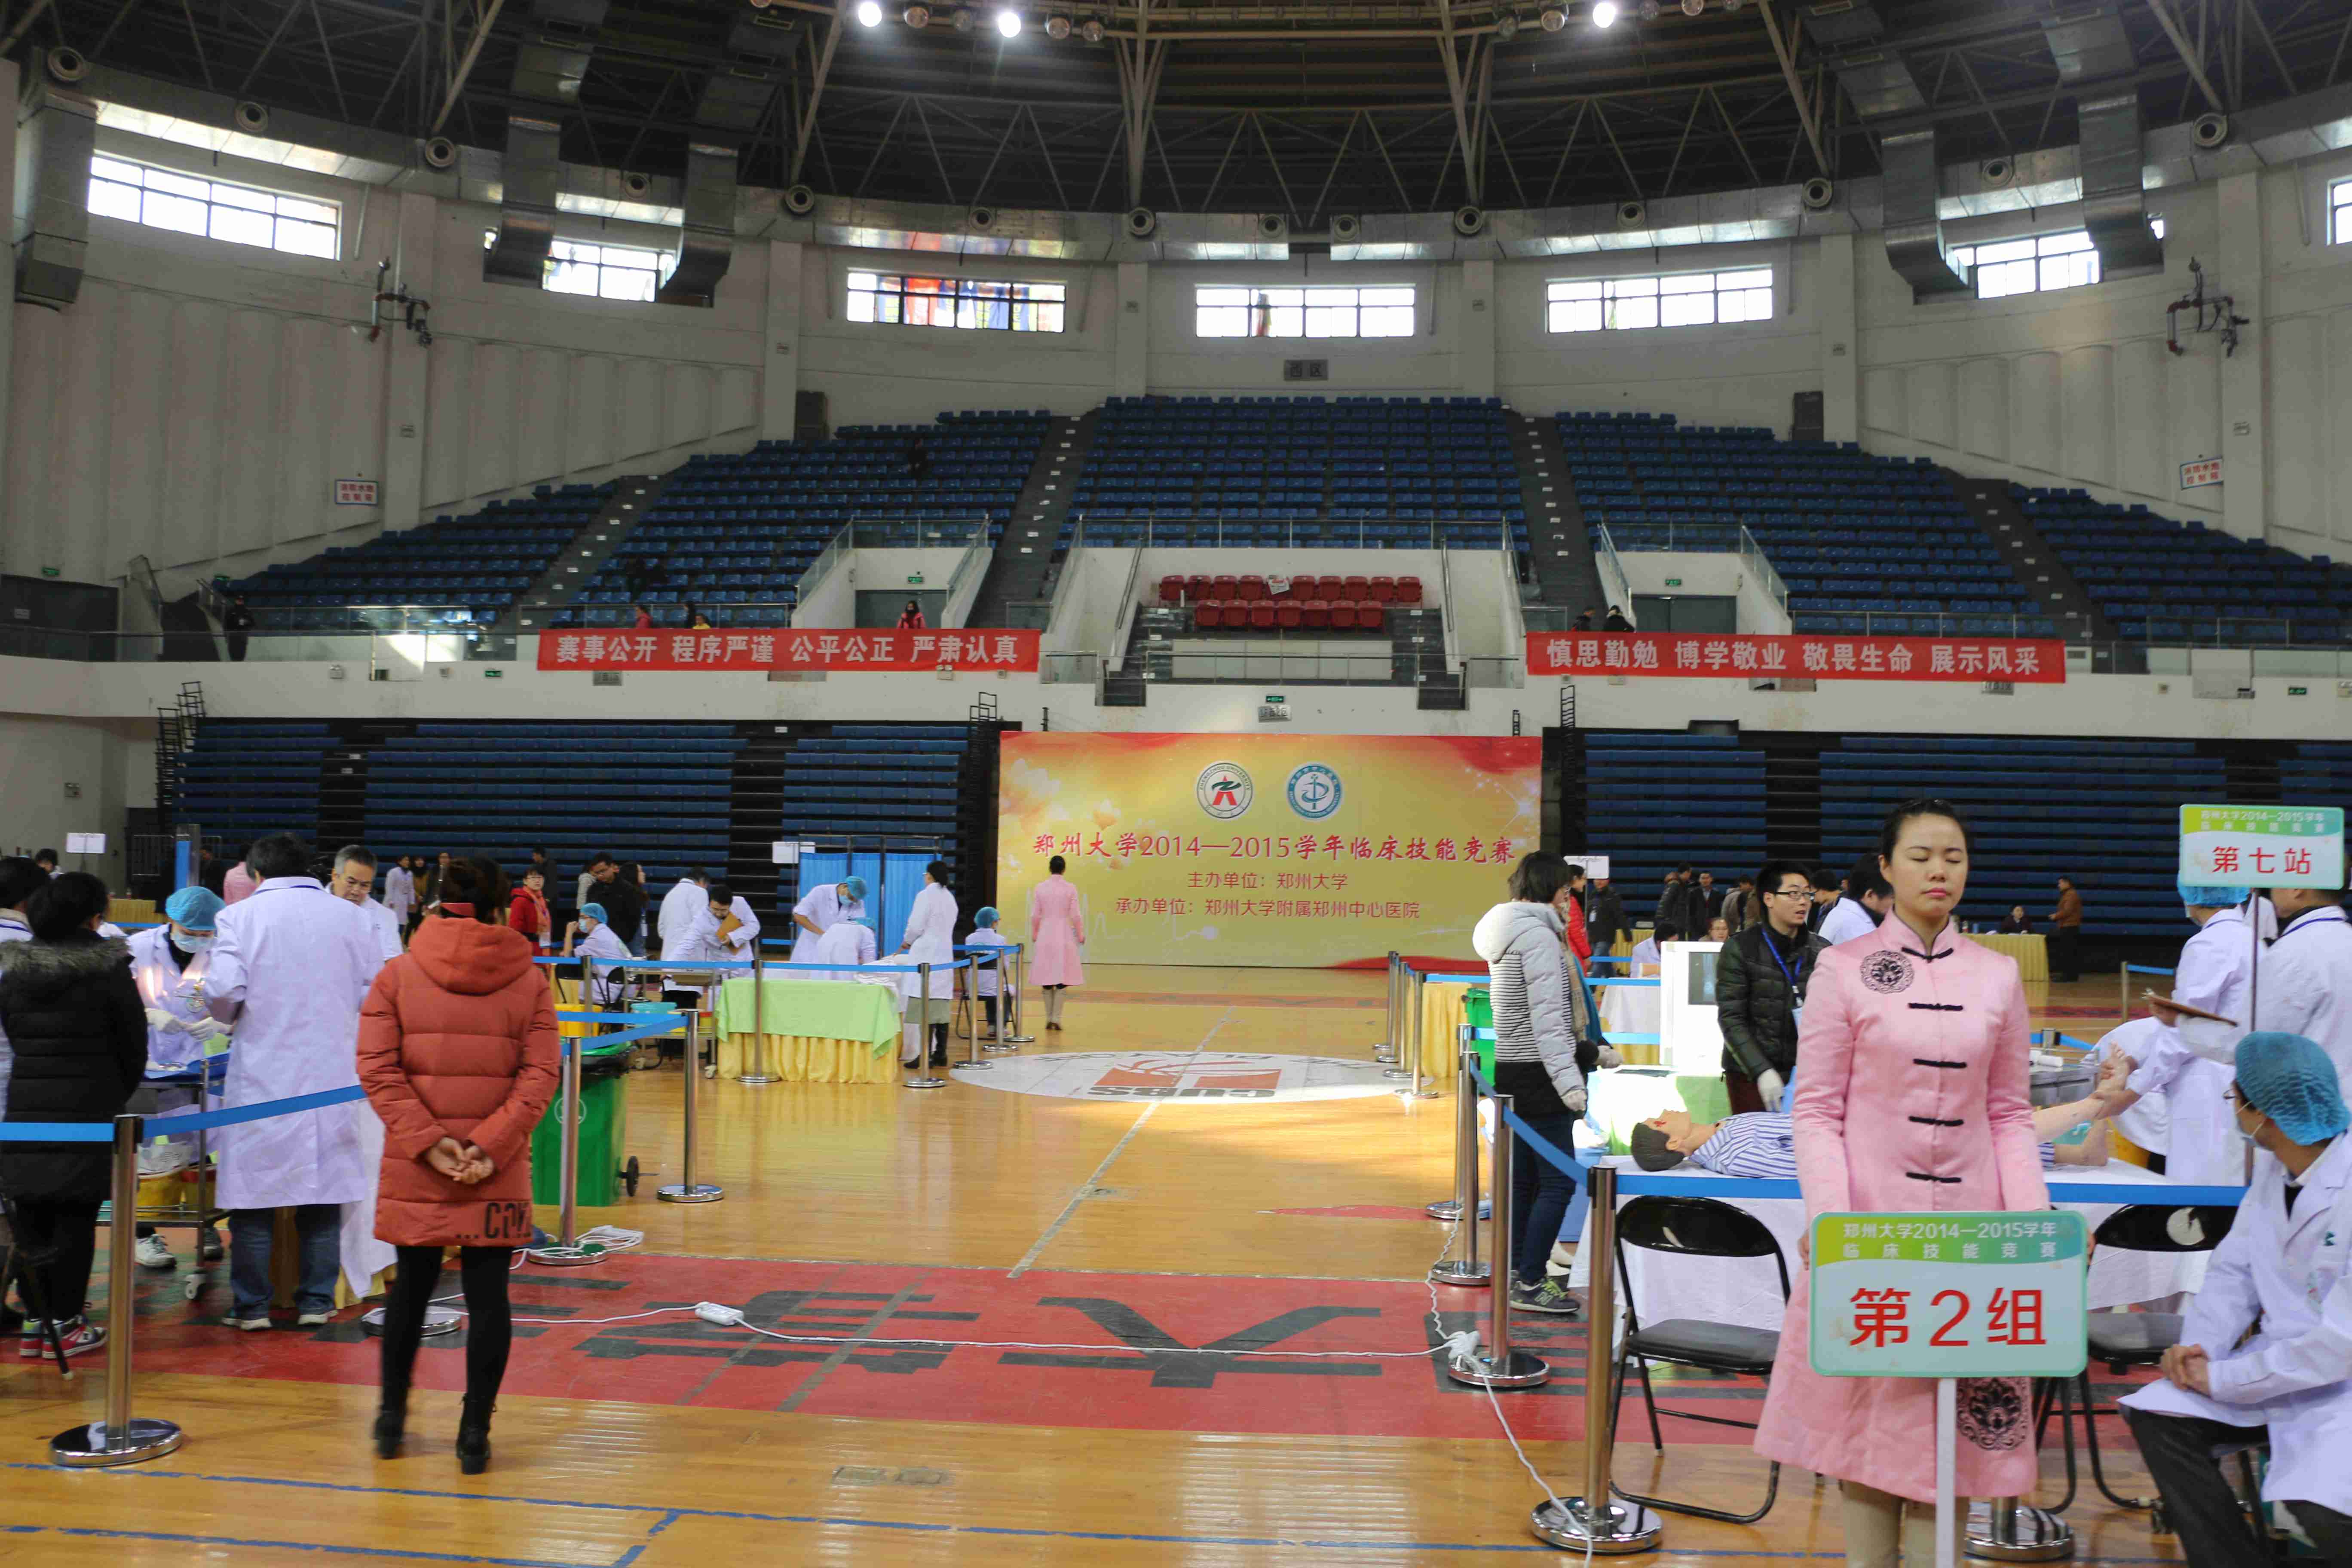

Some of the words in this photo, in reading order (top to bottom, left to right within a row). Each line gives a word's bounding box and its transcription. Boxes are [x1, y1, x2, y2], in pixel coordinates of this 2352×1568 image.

[557, 636, 657, 663] 赛事公开
[672, 635, 775, 663] 程序严谨
[790, 636, 894, 663] 公平公正
[910, 636, 1018, 663] 严肃认真
[1547, 639, 1659, 668] 慎思勤勉
[1675, 641, 1786, 670] 博学敬业
[1802, 643, 1913, 673] 敬畏生命
[1930, 645, 2040, 674] 展示风采
[2212, 846, 2312, 874] 第七站
[1087, 1086, 1275, 1098] CUBS
[1850, 1288, 2046, 1348] 第2组
